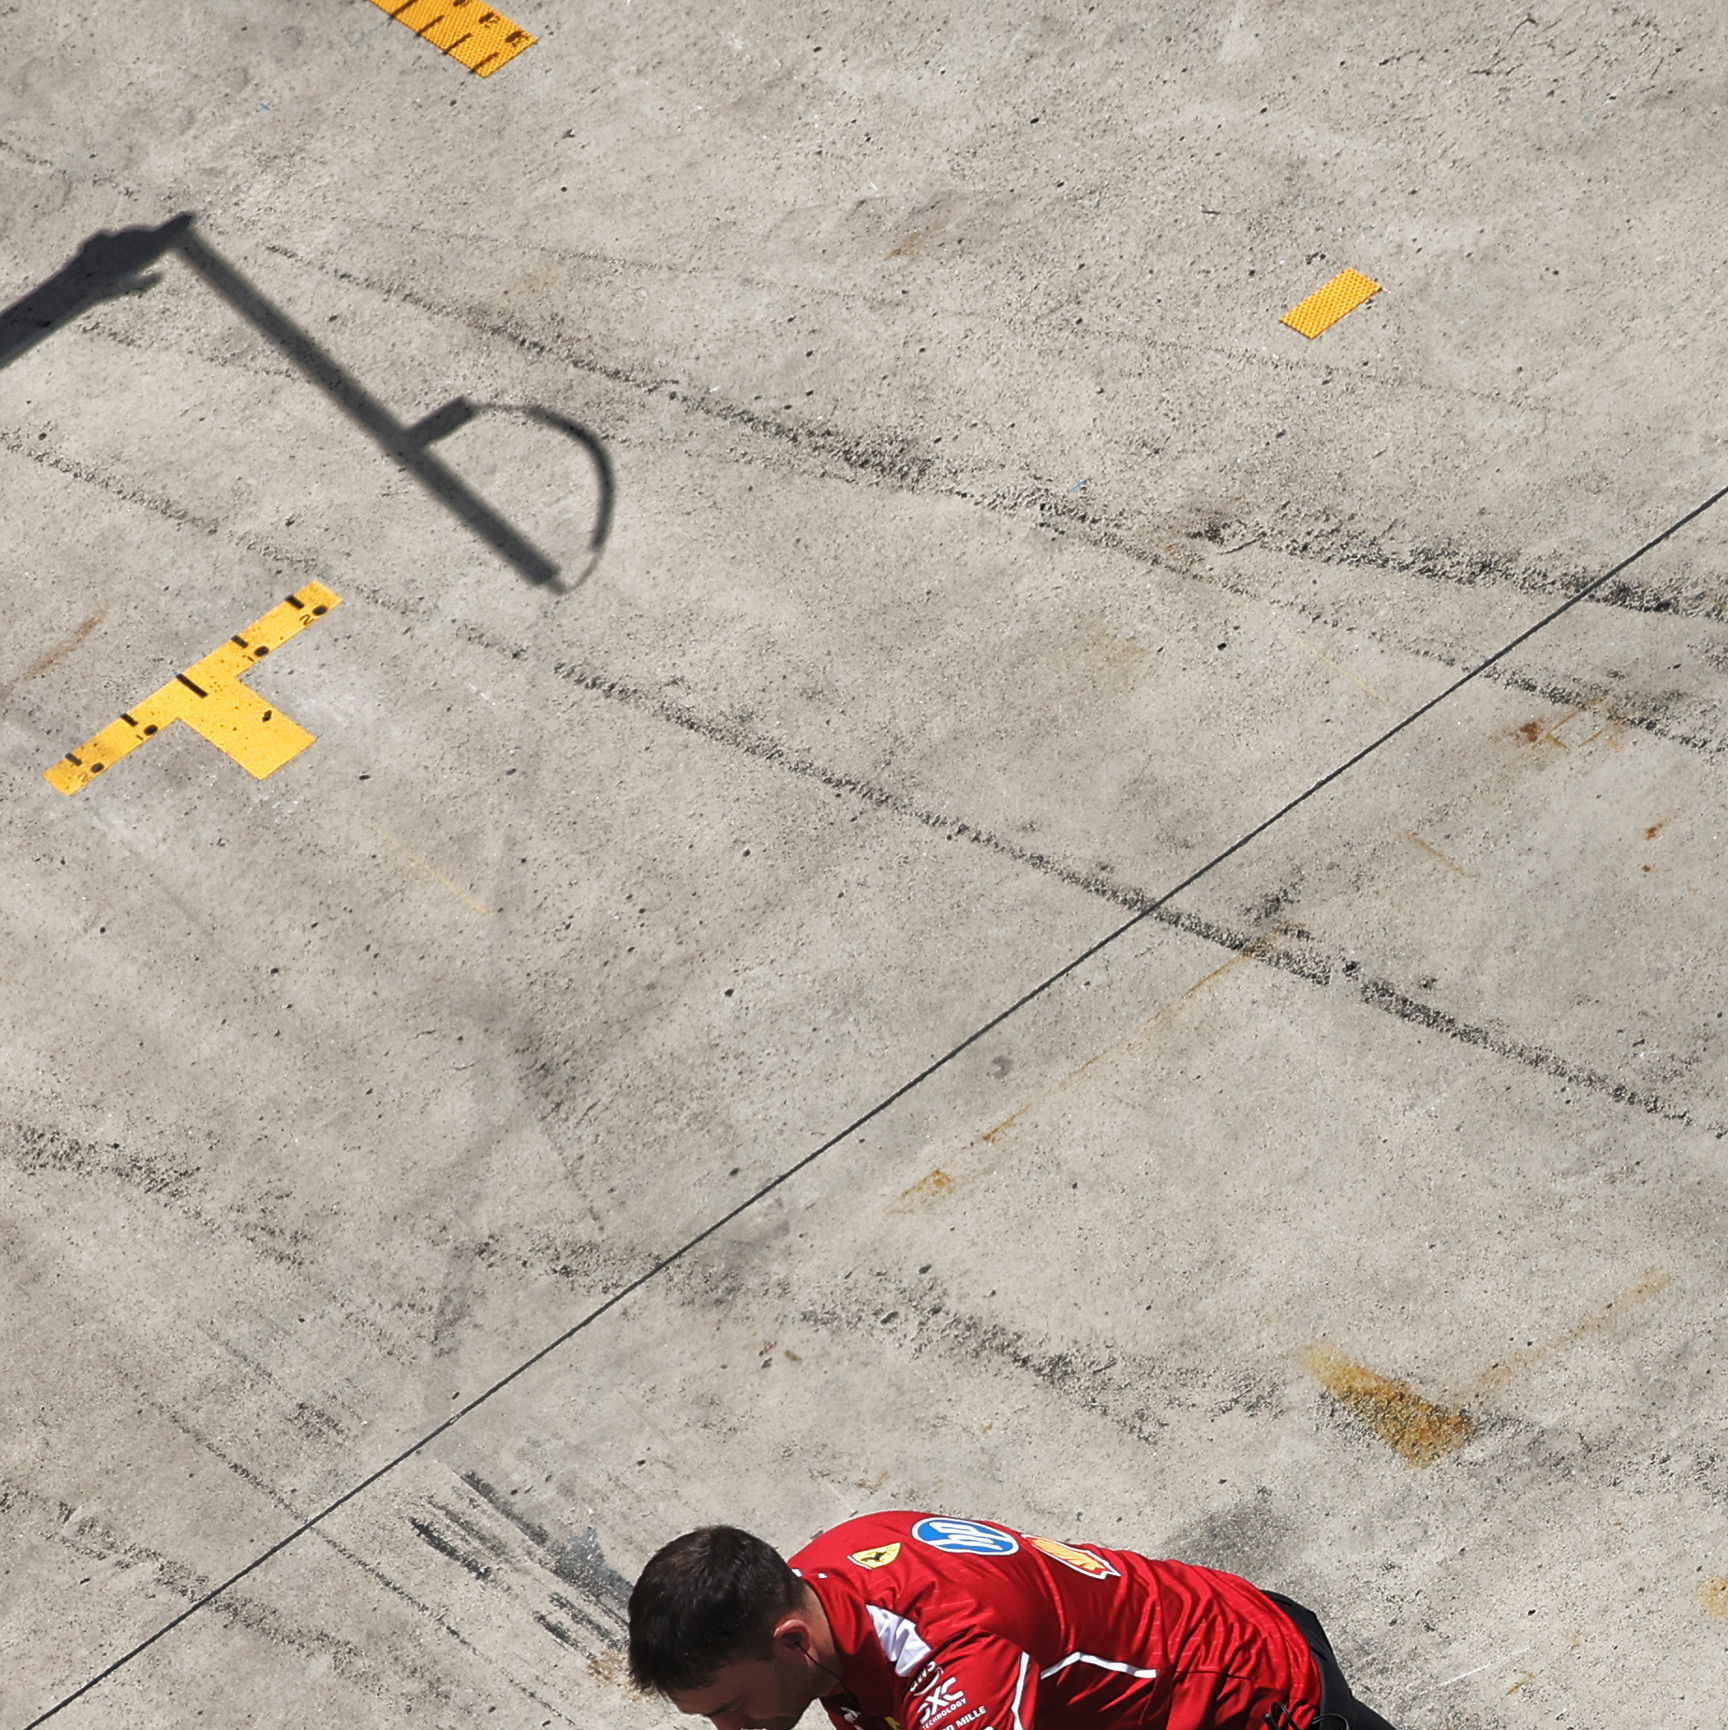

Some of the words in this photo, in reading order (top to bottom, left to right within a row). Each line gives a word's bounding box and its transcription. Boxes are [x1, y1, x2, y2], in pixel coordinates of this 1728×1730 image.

[913, 1518, 1018, 1554] hp
[922, 1697, 967, 1730] TECHNOLOGY
[955, 1705, 987, 1729] MILLE
